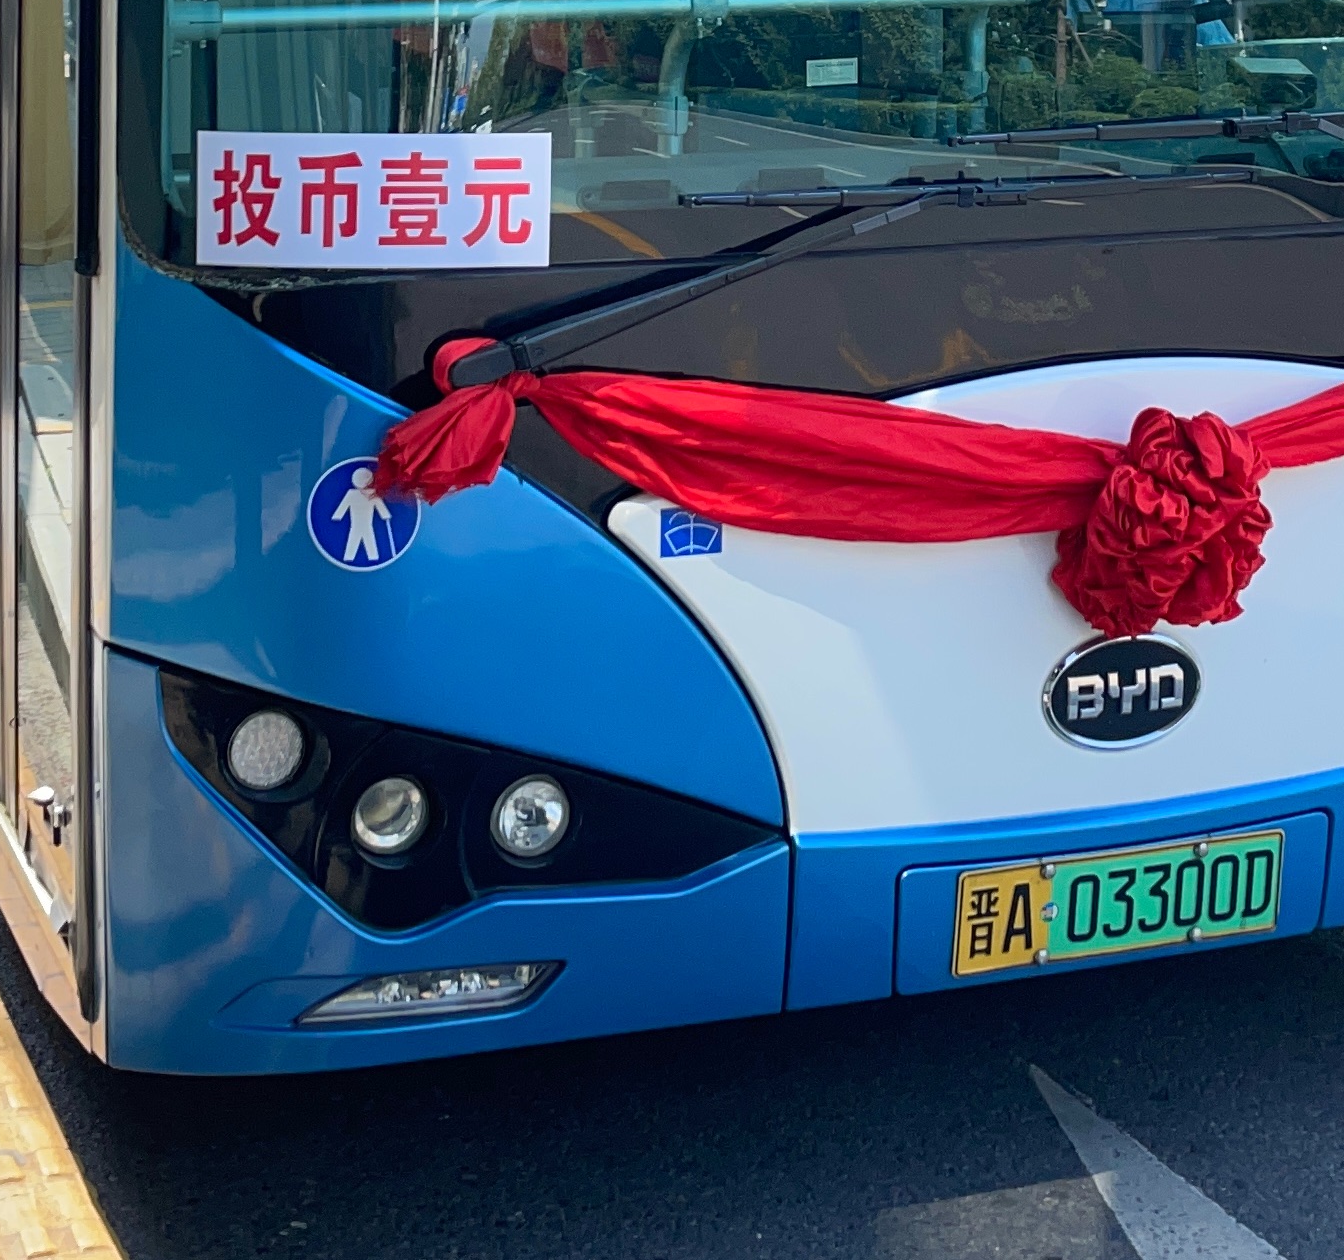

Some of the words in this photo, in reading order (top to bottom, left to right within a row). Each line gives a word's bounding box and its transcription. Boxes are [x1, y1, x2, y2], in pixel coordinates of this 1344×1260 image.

[213, 150, 533, 248] 投币壹元
[1066, 662, 1185, 721] BYD
[967, 882, 1034, 959] 晋A
[1066, 848, 1275, 943] 03300D
